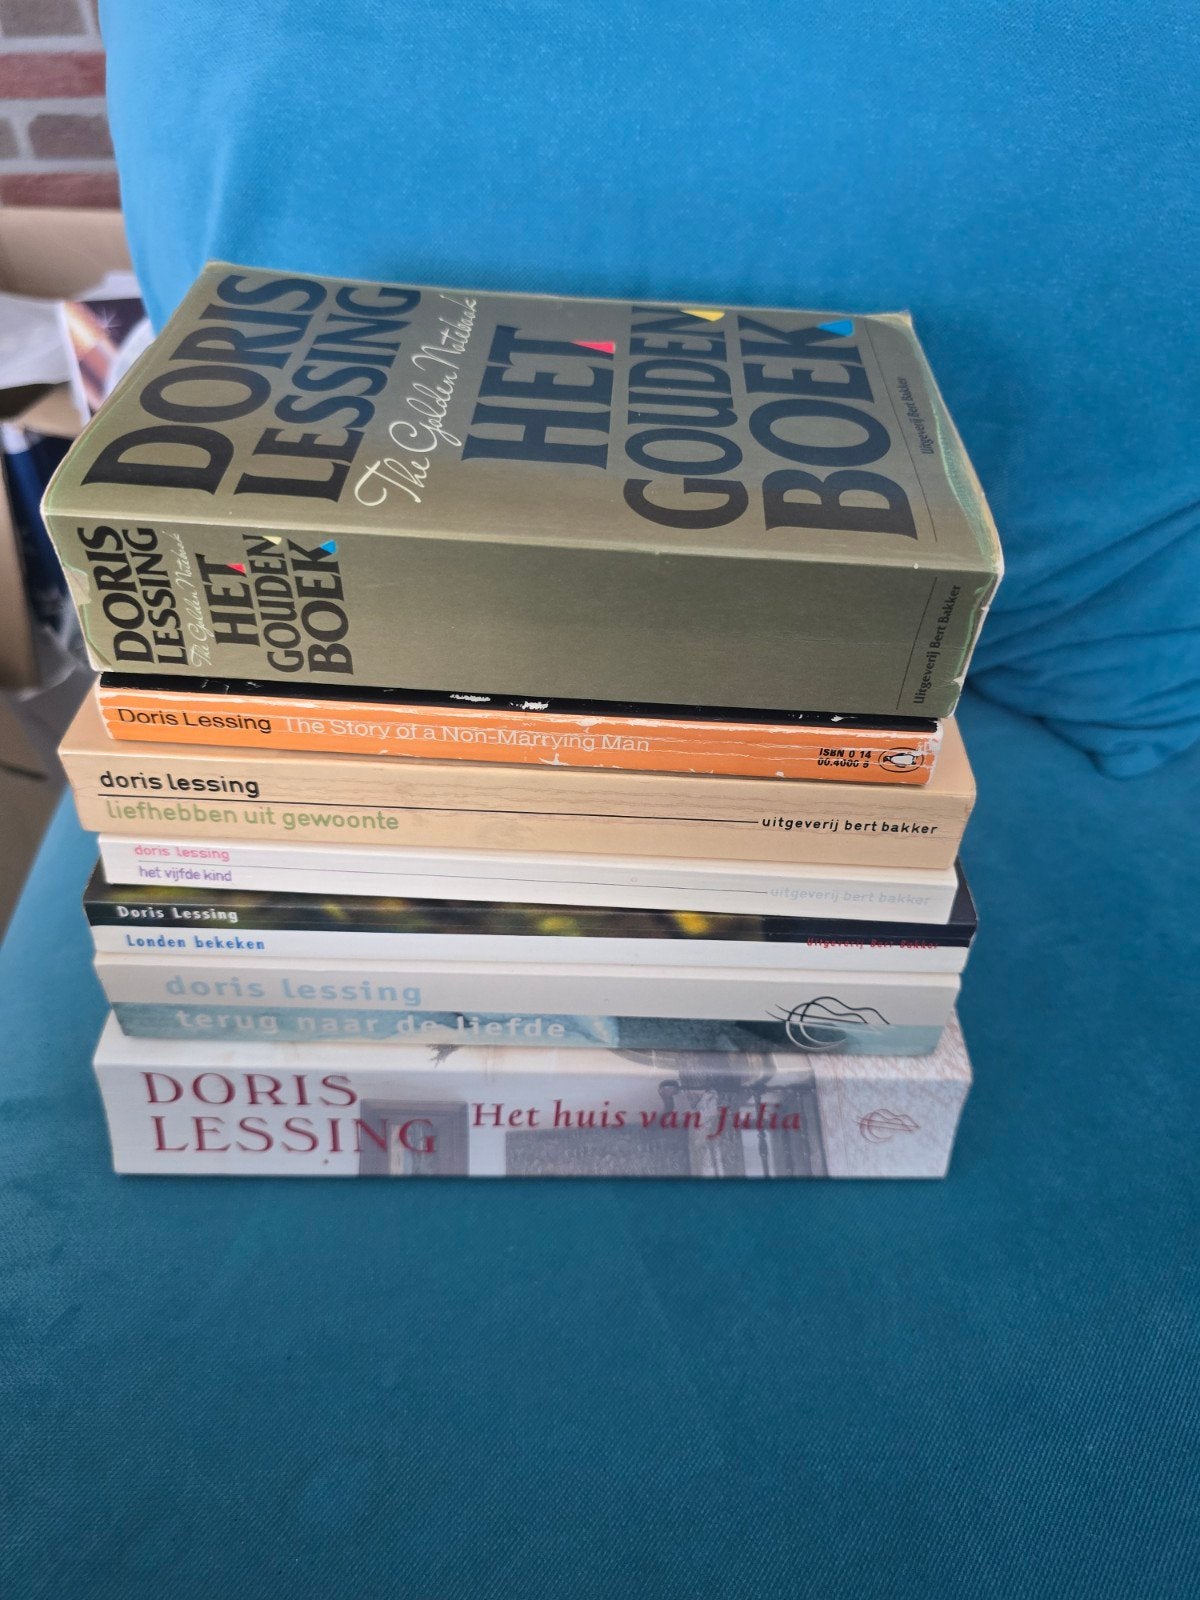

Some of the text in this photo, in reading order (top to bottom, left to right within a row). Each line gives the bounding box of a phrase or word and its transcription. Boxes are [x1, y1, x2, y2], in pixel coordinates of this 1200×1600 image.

[81, 274, 328, 495] DORIS
[234, 286, 421, 502] LESSING
[354, 294, 476, 506] The Golden Notebook
[462, 324, 615, 469] HET
[623, 306, 749, 530] GOUDEN
[737, 314, 918, 541] BOEK
[77, 525, 155, 664] DORIS
[122, 527, 190, 665] LESSING
[195, 553, 260, 647] HET
[243, 534, 305, 673] GOUDEN
[287, 539, 354, 675] BOEK
[184, 591, 215, 642] Golden
[190, 644, 213, 667] The
[913, 585, 961, 704] Uitgeverij Bert Bakker
[117, 708, 650, 751] Doris Lessing The Story of a Non-Marrying Man
[818, 747, 871, 759] ISBN 0 14
[100, 771, 260, 798] doris lessing
[106, 800, 399, 830] liefhebben uit gewoonte
[762, 817, 938, 834] uitgeverij bert bakker
[134, 845, 230, 862] doris lessing
[138, 865, 232, 882] het vijfde kind
[116, 905, 239, 923] Doris Lessing
[770, 887, 931, 906] uitgeverij bert bakker
[125, 934, 265, 950] Londen bekeken
[165, 974, 422, 1007] doris lessing
[175, 1009, 567, 1038] terug naar de liefde
[140, 1071, 360, 1107] DORIS
[151, 1115, 436, 1153] LESSING
[470, 1099, 802, 1140] Het huis van Julia
